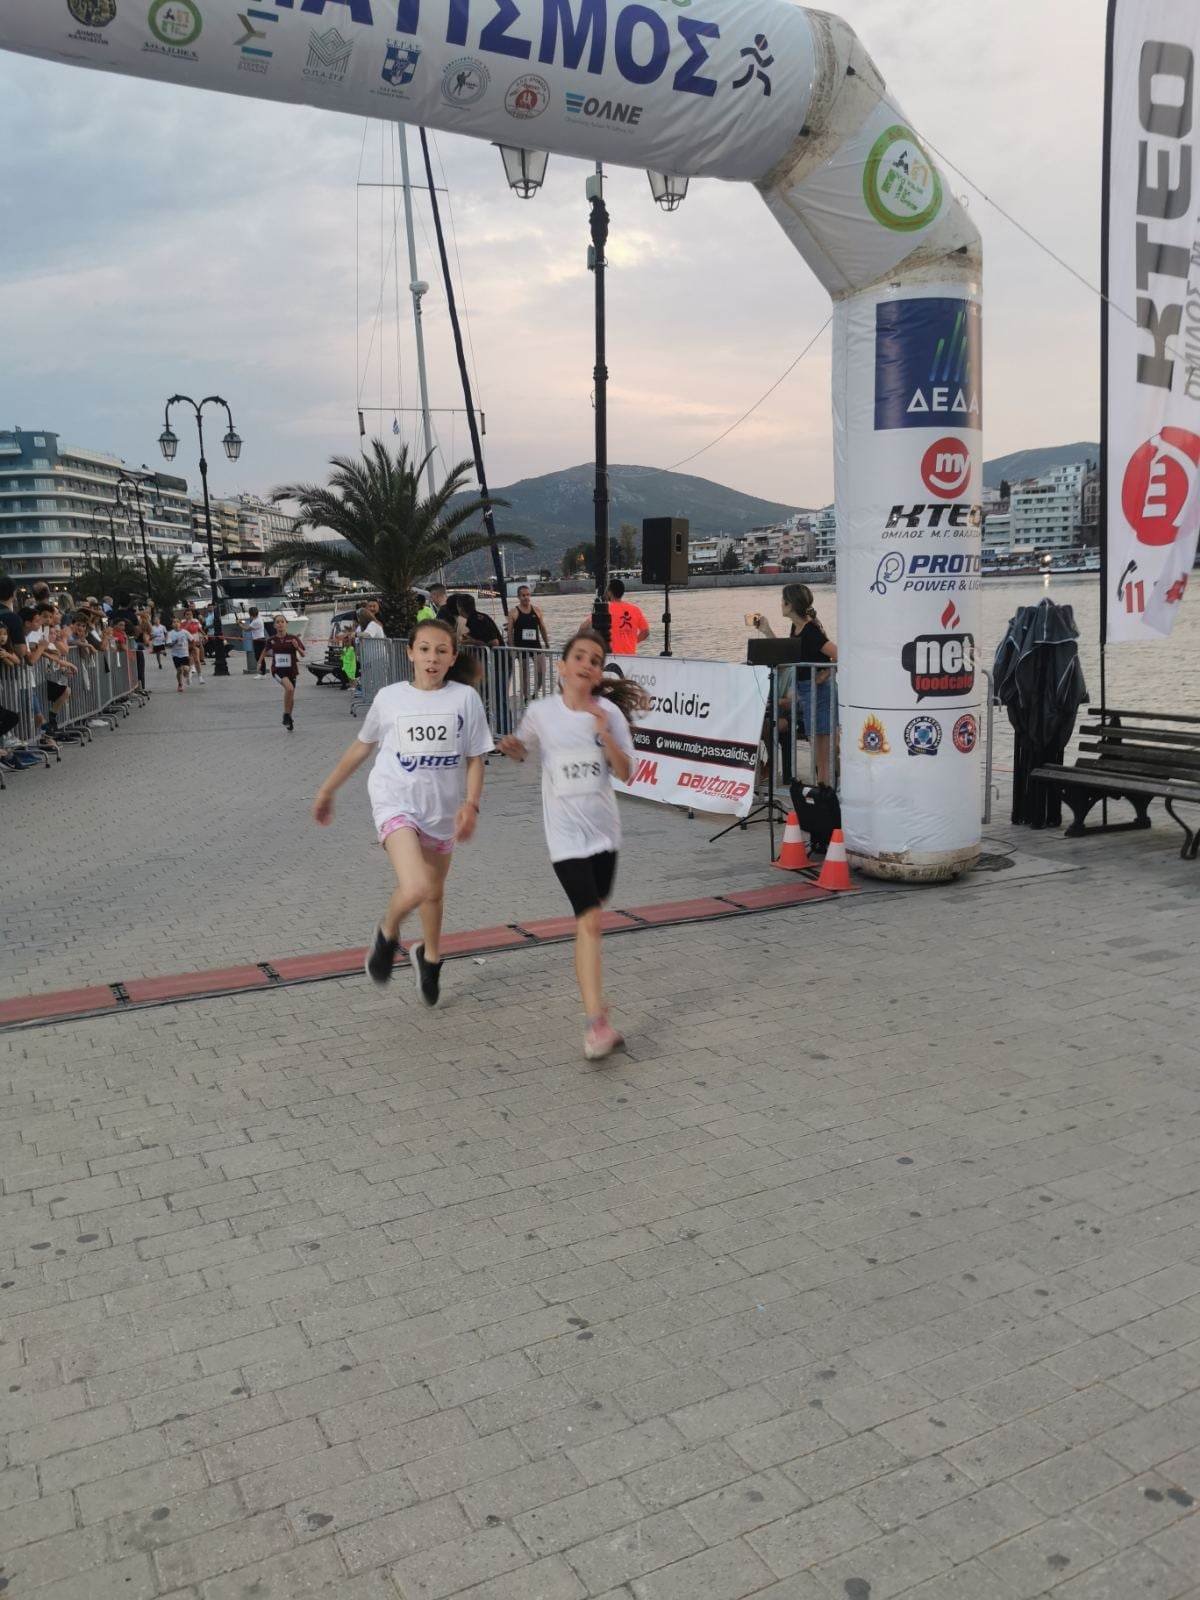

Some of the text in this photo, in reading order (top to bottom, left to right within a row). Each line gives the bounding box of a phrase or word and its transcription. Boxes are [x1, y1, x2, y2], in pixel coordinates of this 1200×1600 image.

[275, 0, 720, 97] ΙΣΜΟΣ
[1136, 40, 1195, 392] ΚΤΕΟ
[882, 530, 924, 539] ΟΜΙΛΟΣ
[903, 580, 957, 592] POWER
[959, 580, 966, 591] &
[915, 636, 974, 675] net
[406, 725, 447, 741] 1302
